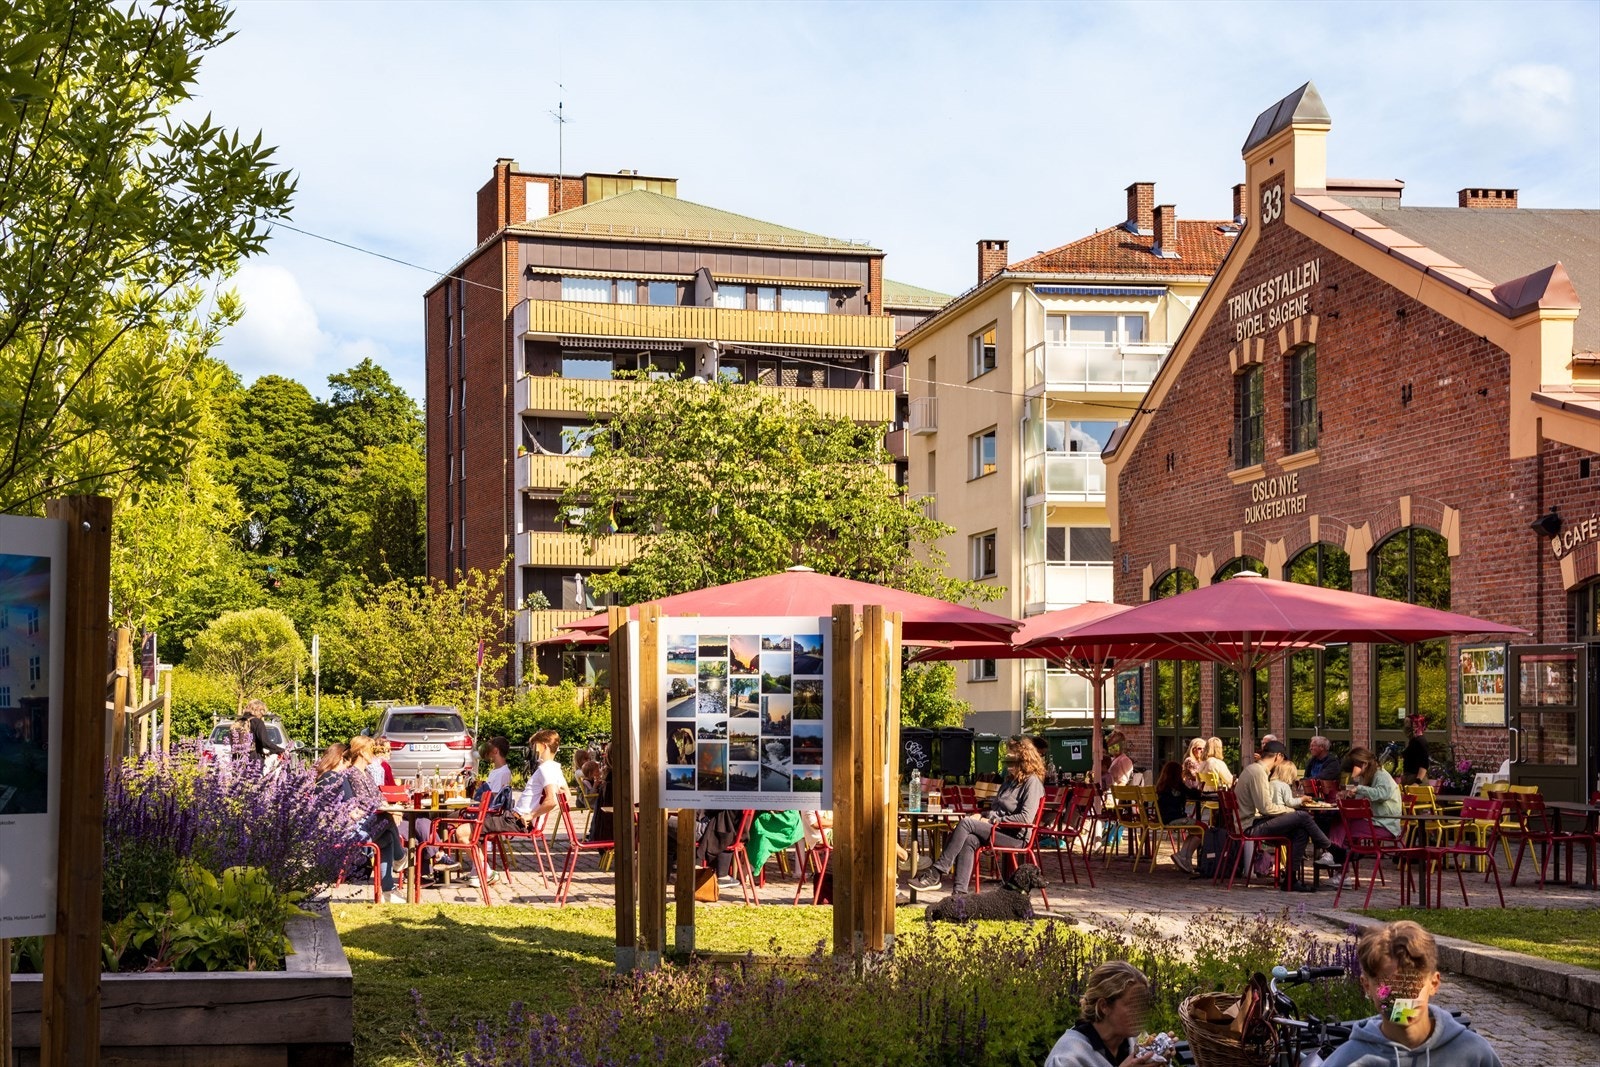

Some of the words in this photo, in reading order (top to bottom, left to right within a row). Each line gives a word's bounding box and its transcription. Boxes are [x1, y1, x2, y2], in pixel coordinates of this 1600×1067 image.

[1263, 184, 1282, 224] 33
[1227, 257, 1320, 321] TRIKKESTALLEN
[1236, 313, 1266, 342] BYDEL
[1268, 293, 1309, 329] SAGENE
[1252, 478, 1277, 503] OSLO
[1280, 472, 1299, 496] NYE
[1245, 494, 1307, 524] DUKKETEATRET
[1563, 513, 1600, 550] CAFÉ
[1464, 695, 1483, 705] JUL
